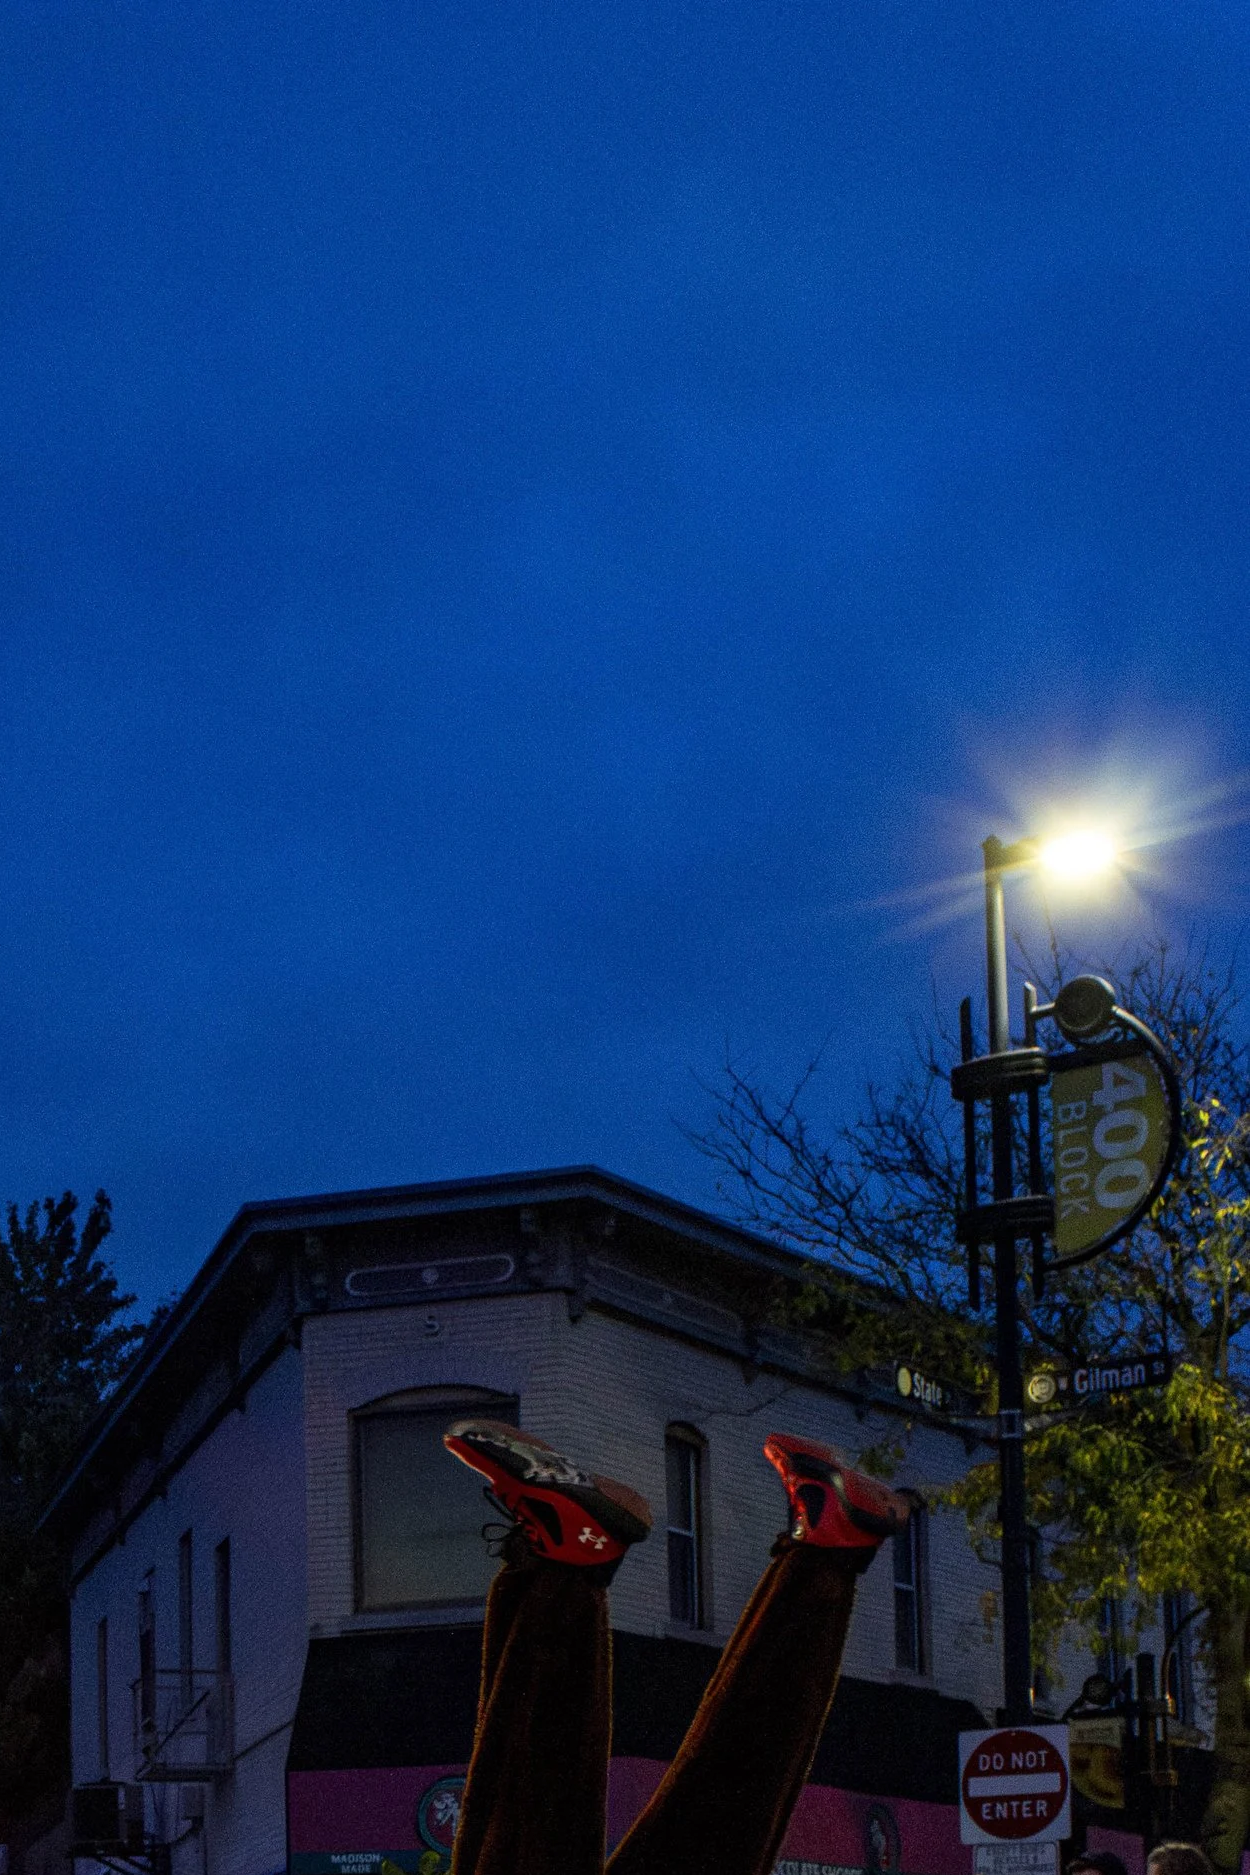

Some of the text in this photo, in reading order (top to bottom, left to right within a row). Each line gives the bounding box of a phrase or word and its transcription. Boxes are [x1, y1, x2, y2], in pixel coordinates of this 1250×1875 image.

[1092, 1061, 1150, 1210] 400
[1056, 1099, 1090, 1221] BLOCK
[1073, 1362, 1147, 1395] Gilman
[978, 1749, 1049, 1772] DO NOT
[981, 1799, 1049, 1821] ENTER
[340, 1863, 372, 1875] MADE
